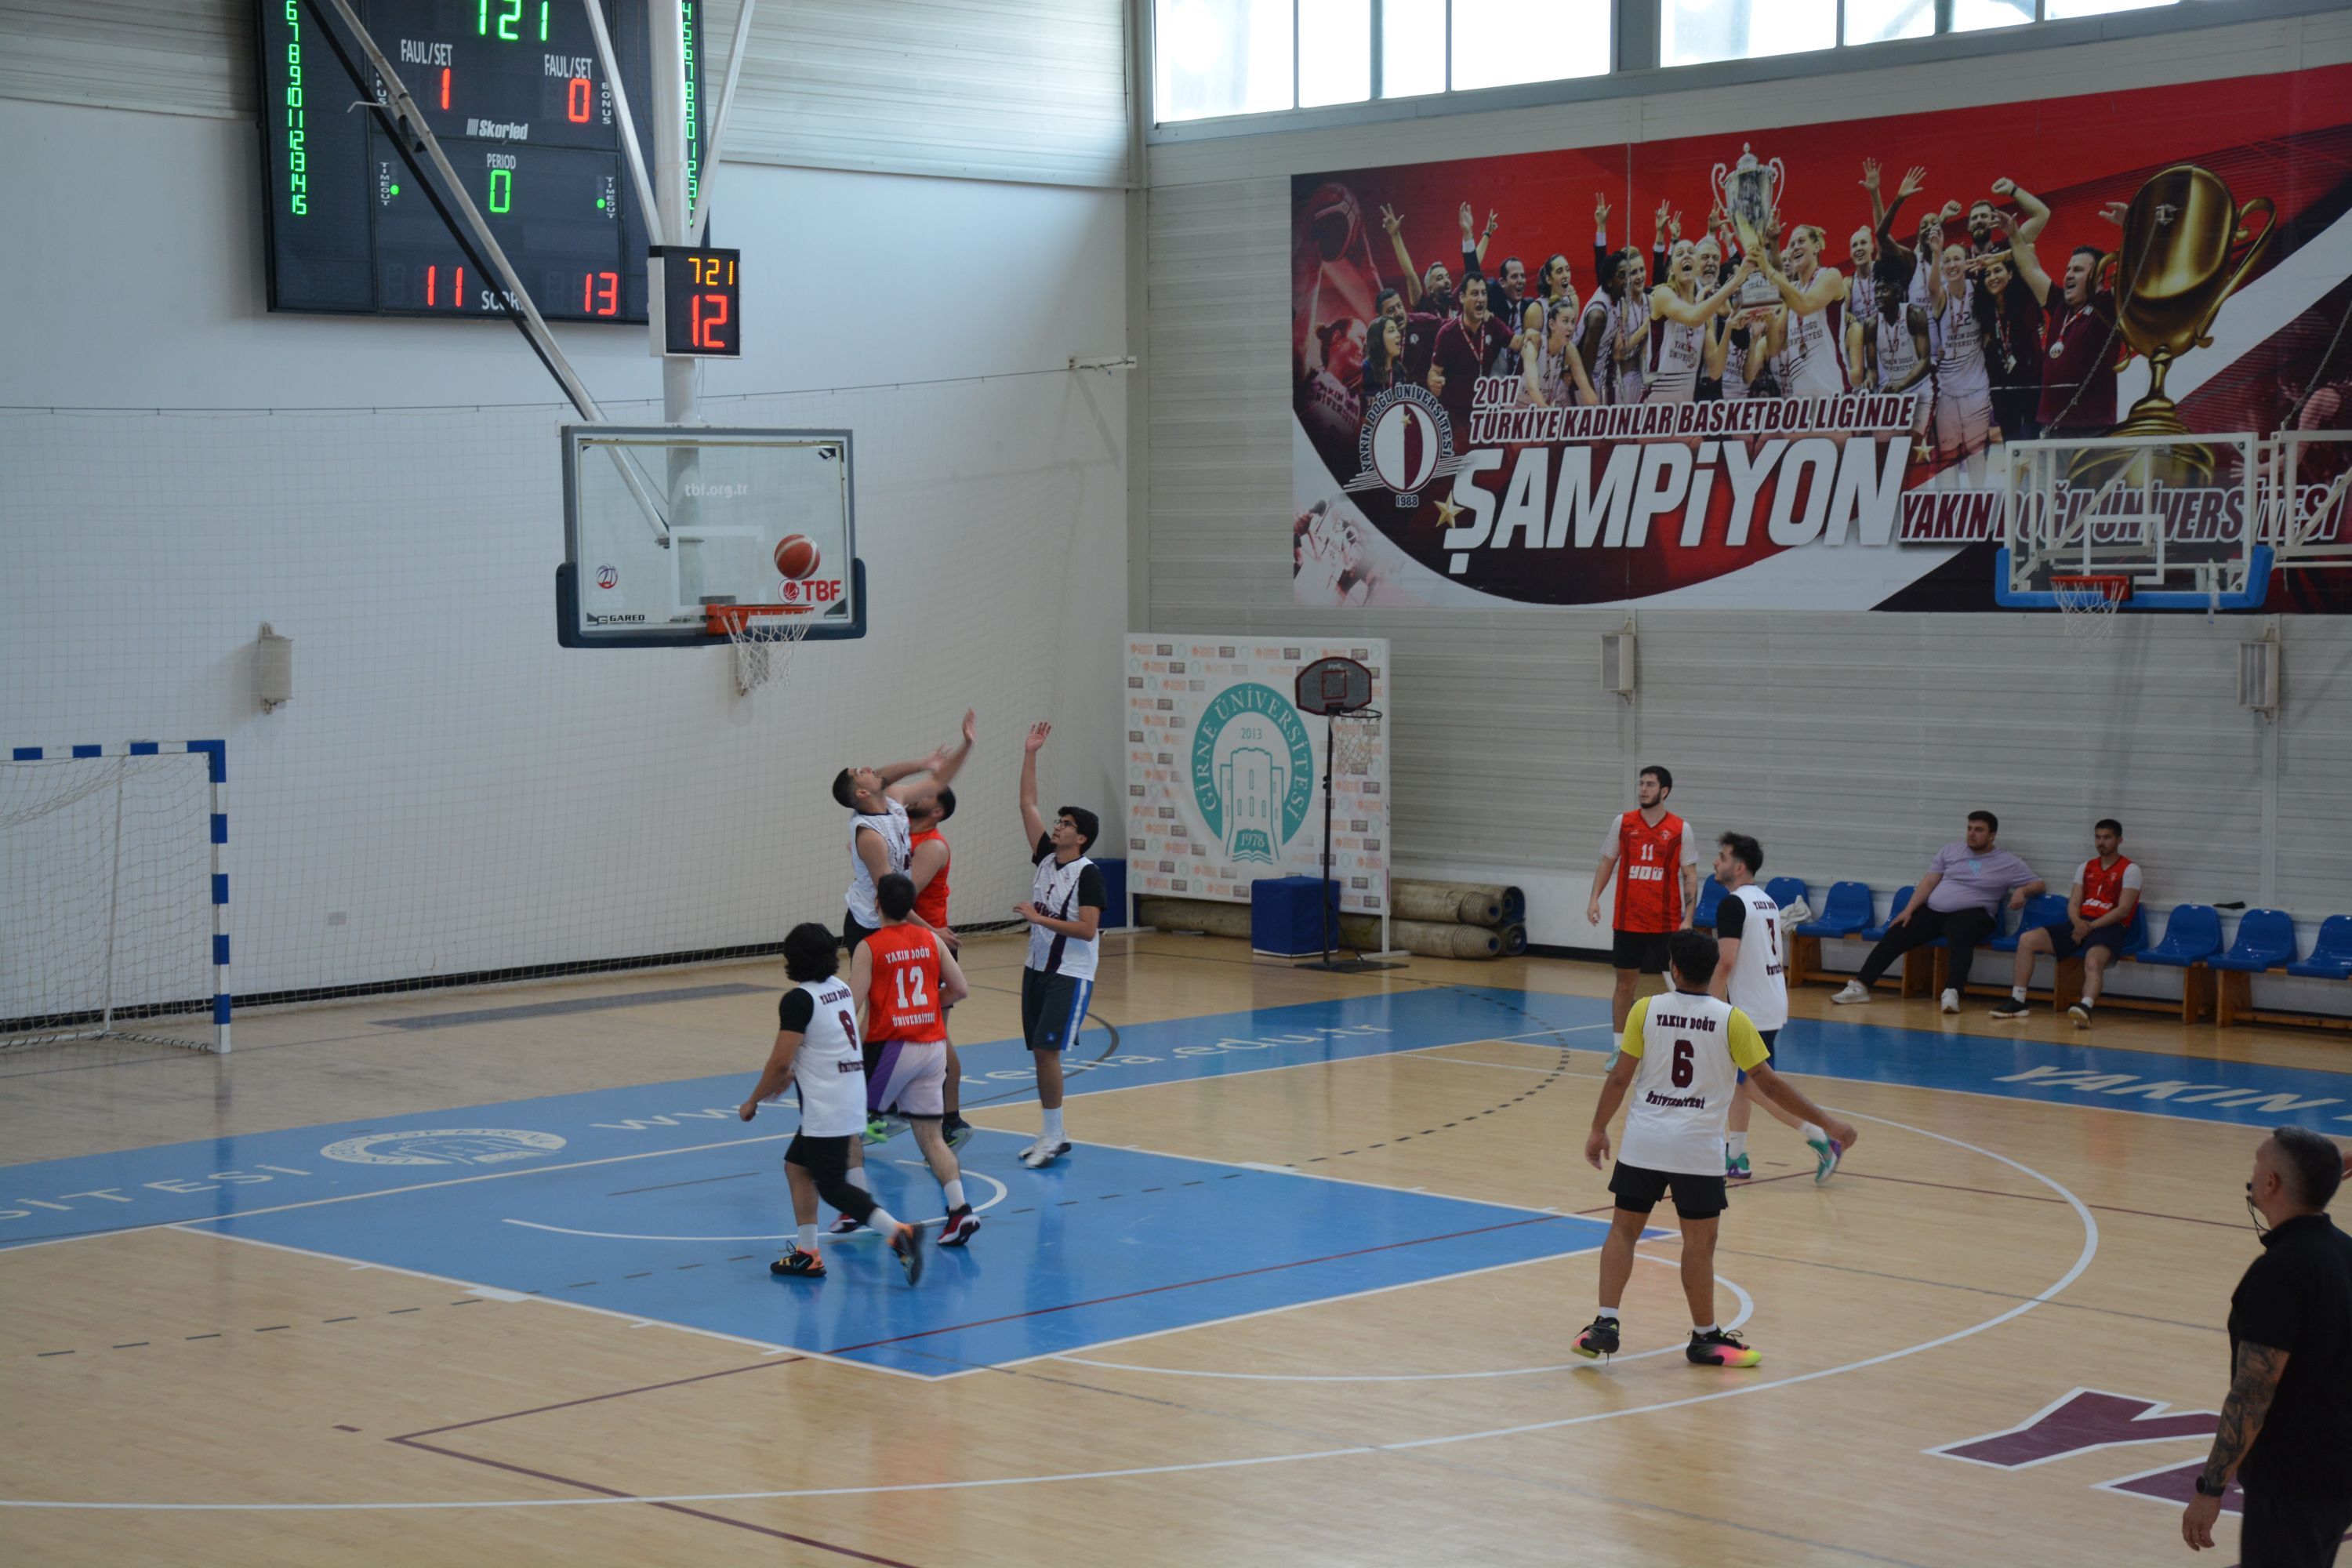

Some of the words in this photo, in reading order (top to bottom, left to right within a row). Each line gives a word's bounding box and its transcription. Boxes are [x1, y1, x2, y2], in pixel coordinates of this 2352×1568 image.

[286, 0, 297, 20] 6
[288, 22, 299, 42] 7
[289, 44, 299, 64] 8
[401, 39, 452, 67] FAUL/SET
[289, 66, 301, 86] 9
[544, 54, 593, 80] FAUL/SET
[287, 87, 302, 107] 10
[442, 68, 451, 110] 1
[568, 78, 590, 123] 0
[601, 82, 612, 125] BONUS
[288, 109, 303, 128] 11
[289, 130, 304, 150] 12
[478, 119, 528, 141] Skorled
[290, 152, 305, 172] 13
[486, 154, 517, 170] PERIOD
[291, 173, 306, 192] 14
[379, 162, 390, 205] TIMEOUT
[489, 169, 511, 213] 0
[292, 194, 307, 215] 15
[606, 176, 615, 219] TIMEOUT
[427, 265, 463, 307] 11
[585, 273, 618, 315] 13
[481, 289, 524, 311] SCOR
[692, 295, 728, 347] 12
[1473, 377, 1520, 407] 2017
[1471, 401, 1561, 441] TÜRKİYE
[1566, 401, 1675, 437] KADINLAR
[1678, 395, 1811, 434] BASKETBOL
[1817, 391, 1916, 429] LİGİNDE
[1360, 424, 1372, 474] YAKIN
[1367, 390, 1393, 424] DOĞU
[1395, 381, 1455, 457] ÜNİVERSİTESİ
[684, 482, 750, 499] tbf.org.tr
[1396, 494, 1419, 508] 1988
[1900, 491, 1994, 542] YAKIN
[800, 579, 841, 602] TBF
[609, 614, 645, 622] GARED
[1196, 720, 1218, 811] GİRNE
[1214, 685, 1310, 822] ÜNİVERSİTESİ
[1240, 832, 1265, 848] 1978
[1640, 844, 1654, 862] 11
[885, 949, 910, 964] YAKIN
[895, 965, 928, 1009] 12
[1657, 1014, 1689, 1029] YAKIN
[1690, 1015, 1717, 1033] DOĞU
[1671, 1039, 1695, 1089] 6
[1992, 1065, 2347, 1113] YAKIN
